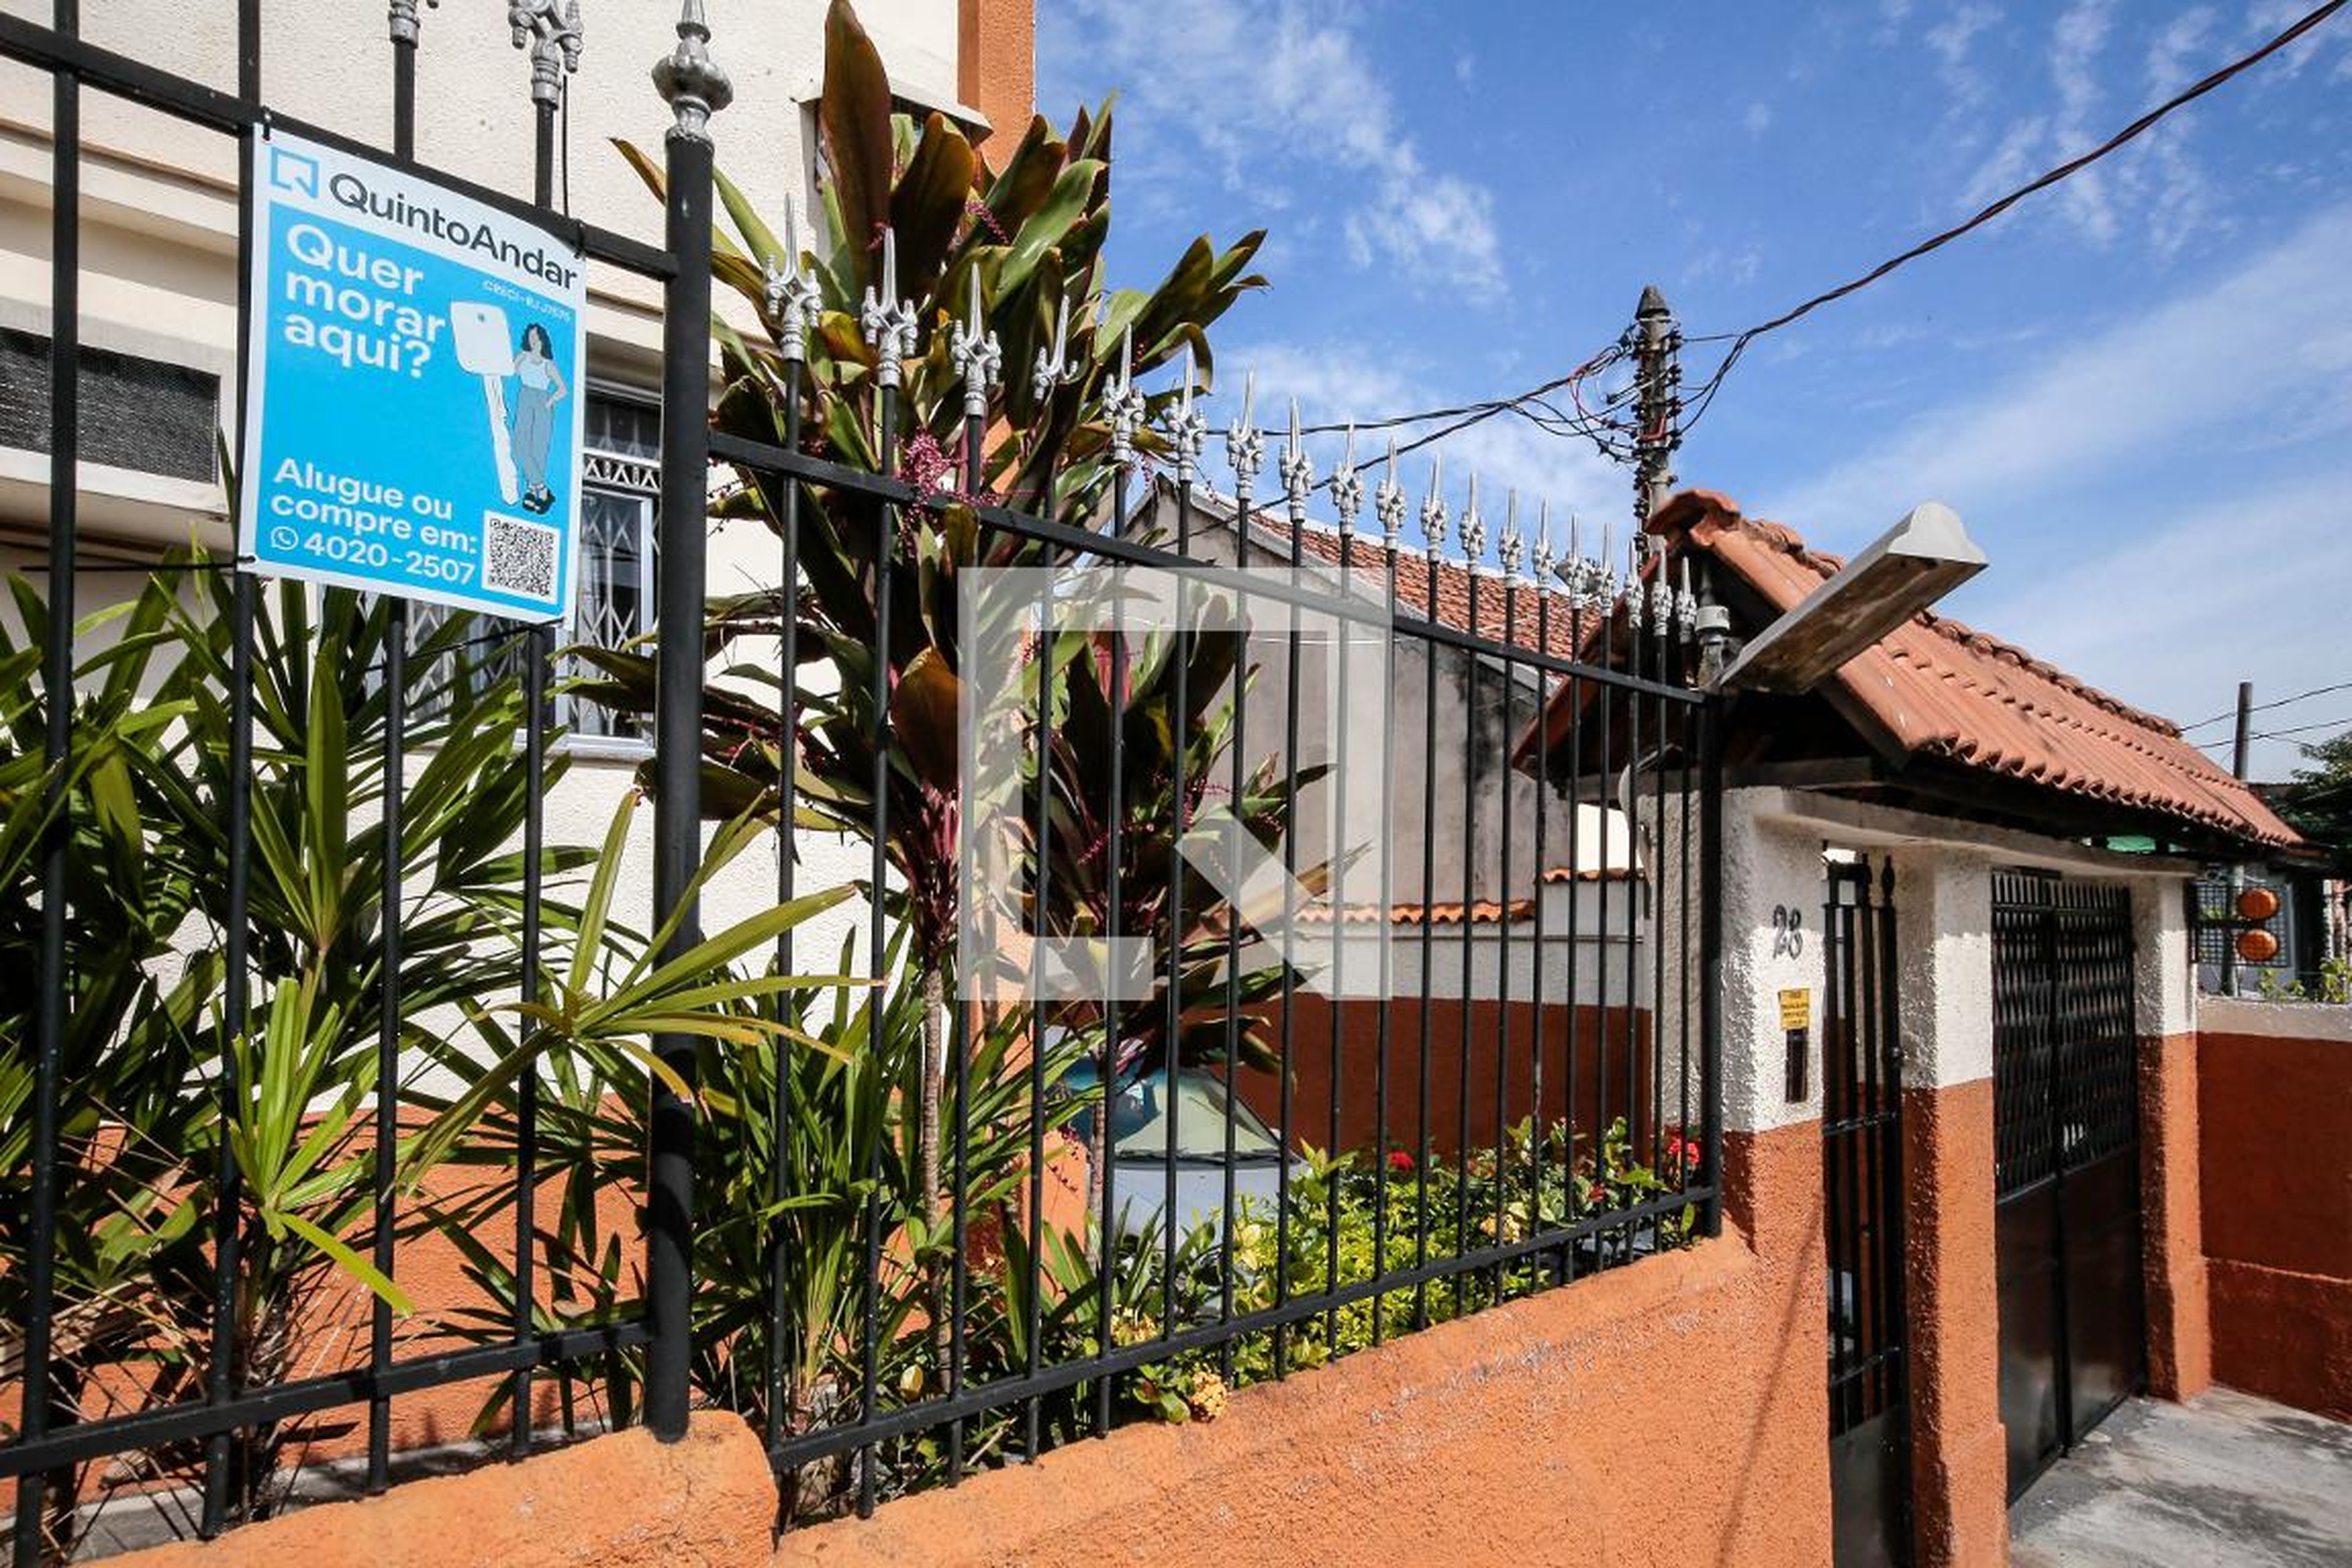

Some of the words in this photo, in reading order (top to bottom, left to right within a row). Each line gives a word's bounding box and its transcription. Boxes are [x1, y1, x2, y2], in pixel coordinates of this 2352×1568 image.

[287, 223, 424, 295] Quer
[330, 173, 577, 290] QuintoAndar
[285, 271, 446, 342] morar
[284, 313, 432, 378] aqui?
[274, 458, 404, 507] Alugue
[412, 494, 453, 521] ou
[271, 494, 412, 538] compre
[420, 526, 478, 554] em:
[303, 532, 476, 585] 4020-2507
